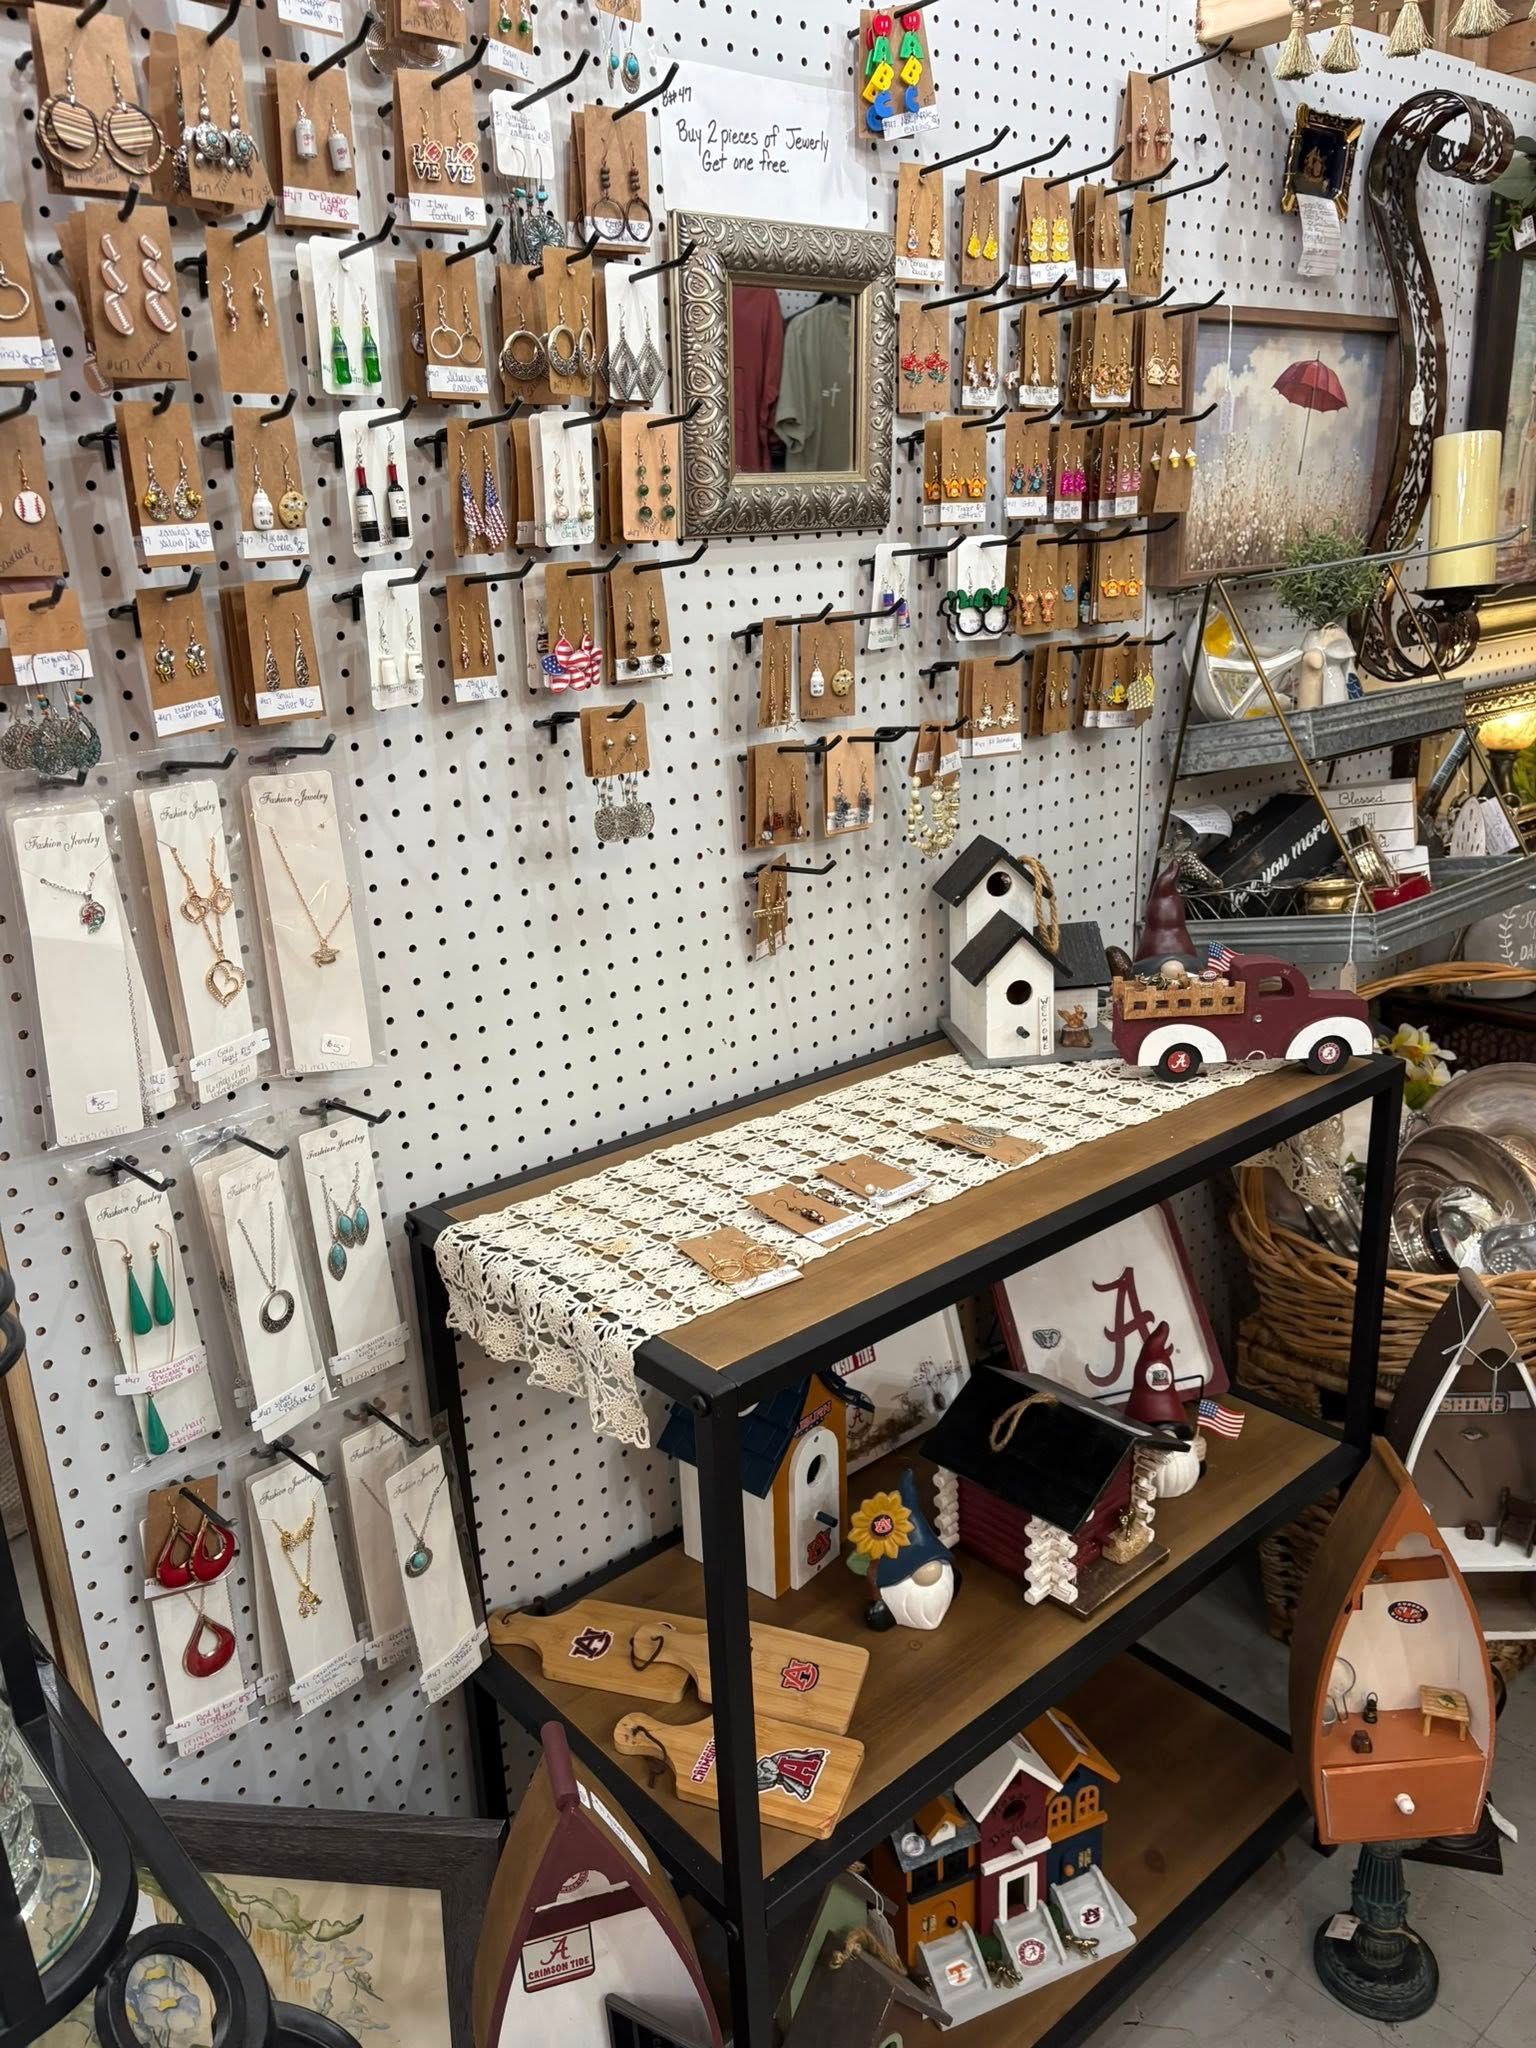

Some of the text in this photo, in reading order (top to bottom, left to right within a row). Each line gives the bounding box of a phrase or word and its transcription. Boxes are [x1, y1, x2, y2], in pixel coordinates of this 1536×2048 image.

[676, 118, 829, 163] Buy 2 pieces of Jewerly
[702, 149, 727, 172] Get
[733, 155, 754, 171] one
[160, 799, 216, 821] Fashion Jewelry
[259, 788, 328, 807] Fashion Jewelry
[1338, 790, 1386, 806] Blessed
[24, 832, 100, 852] Fashion Jewelry
[1261, 852, 1291, 898] you
[1291, 818, 1330, 859] more
[305, 1133, 366, 1160] Fashion Jewelry
[226, 1168, 277, 1200] Fashion Jewelry
[96, 1191, 163, 1223] Fashion Jewelry
[1440, 1398, 1505, 1413] SHING
[350, 1432, 399, 1463] Fashion Jewelry
[258, 1472, 314, 1507] Fashion Jewelry
[393, 1462, 441, 1499] Fashion Jewelry
[778, 1756, 821, 1786] A
[540, 1936, 572, 1966] A
[528, 1963, 569, 1981] CRIMSON
